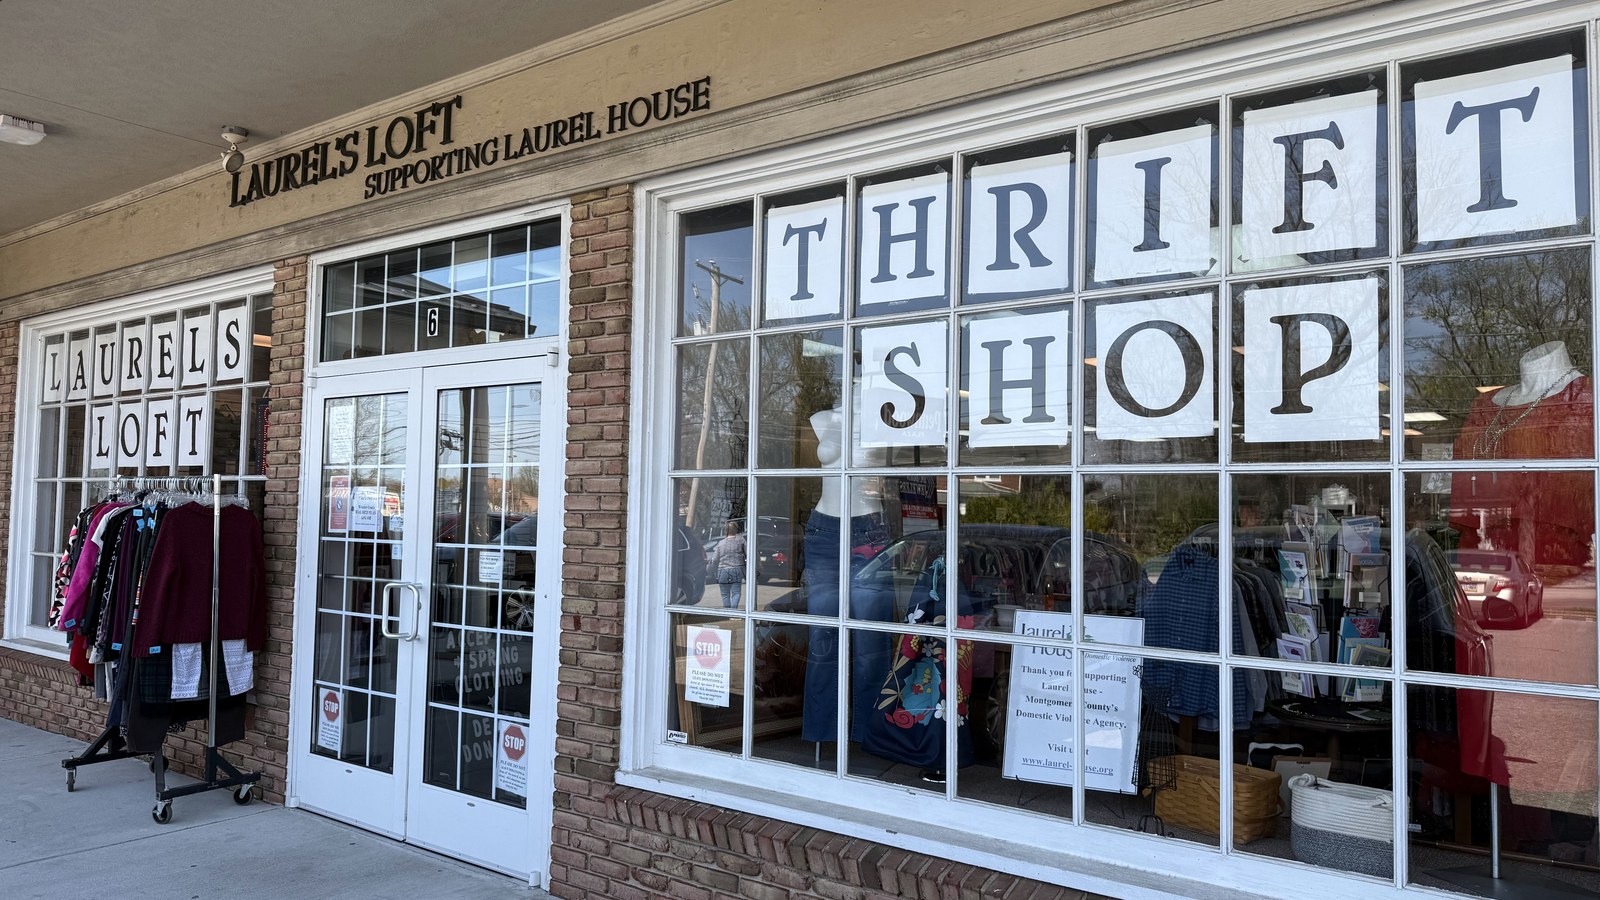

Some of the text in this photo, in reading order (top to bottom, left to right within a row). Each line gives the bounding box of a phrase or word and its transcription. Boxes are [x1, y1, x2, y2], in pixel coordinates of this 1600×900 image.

[364, 76, 711, 200] SUPPORTING LAUREL HOUSE
[228, 95, 462, 208] LAUREL'S LOFT
[783, 86, 1541, 302] THRIFT
[429, 309, 436, 335] 6
[50, 318, 240, 391] LAURELS
[879, 312, 1354, 430] SHOP
[96, 408, 202, 458] LOFT
[447, 625, 522, 649] ACCEPING
[469, 646, 518, 669] SPRNG
[695, 641, 720, 657] STOP
[1021, 665, 1047, 675] Thank
[1049, 669, 1064, 678] you
[1084, 672, 1127, 684] upporting
[1042, 682, 1069, 691] Laurel
[324, 700, 339, 713] STOP
[1025, 695, 1073, 707] Montgomer
[1016, 709, 1053, 720] Domestic
[1093, 718, 1127, 730] Agency.
[504, 734, 525, 751] STOP
[1048, 743, 1067, 753] Visit
